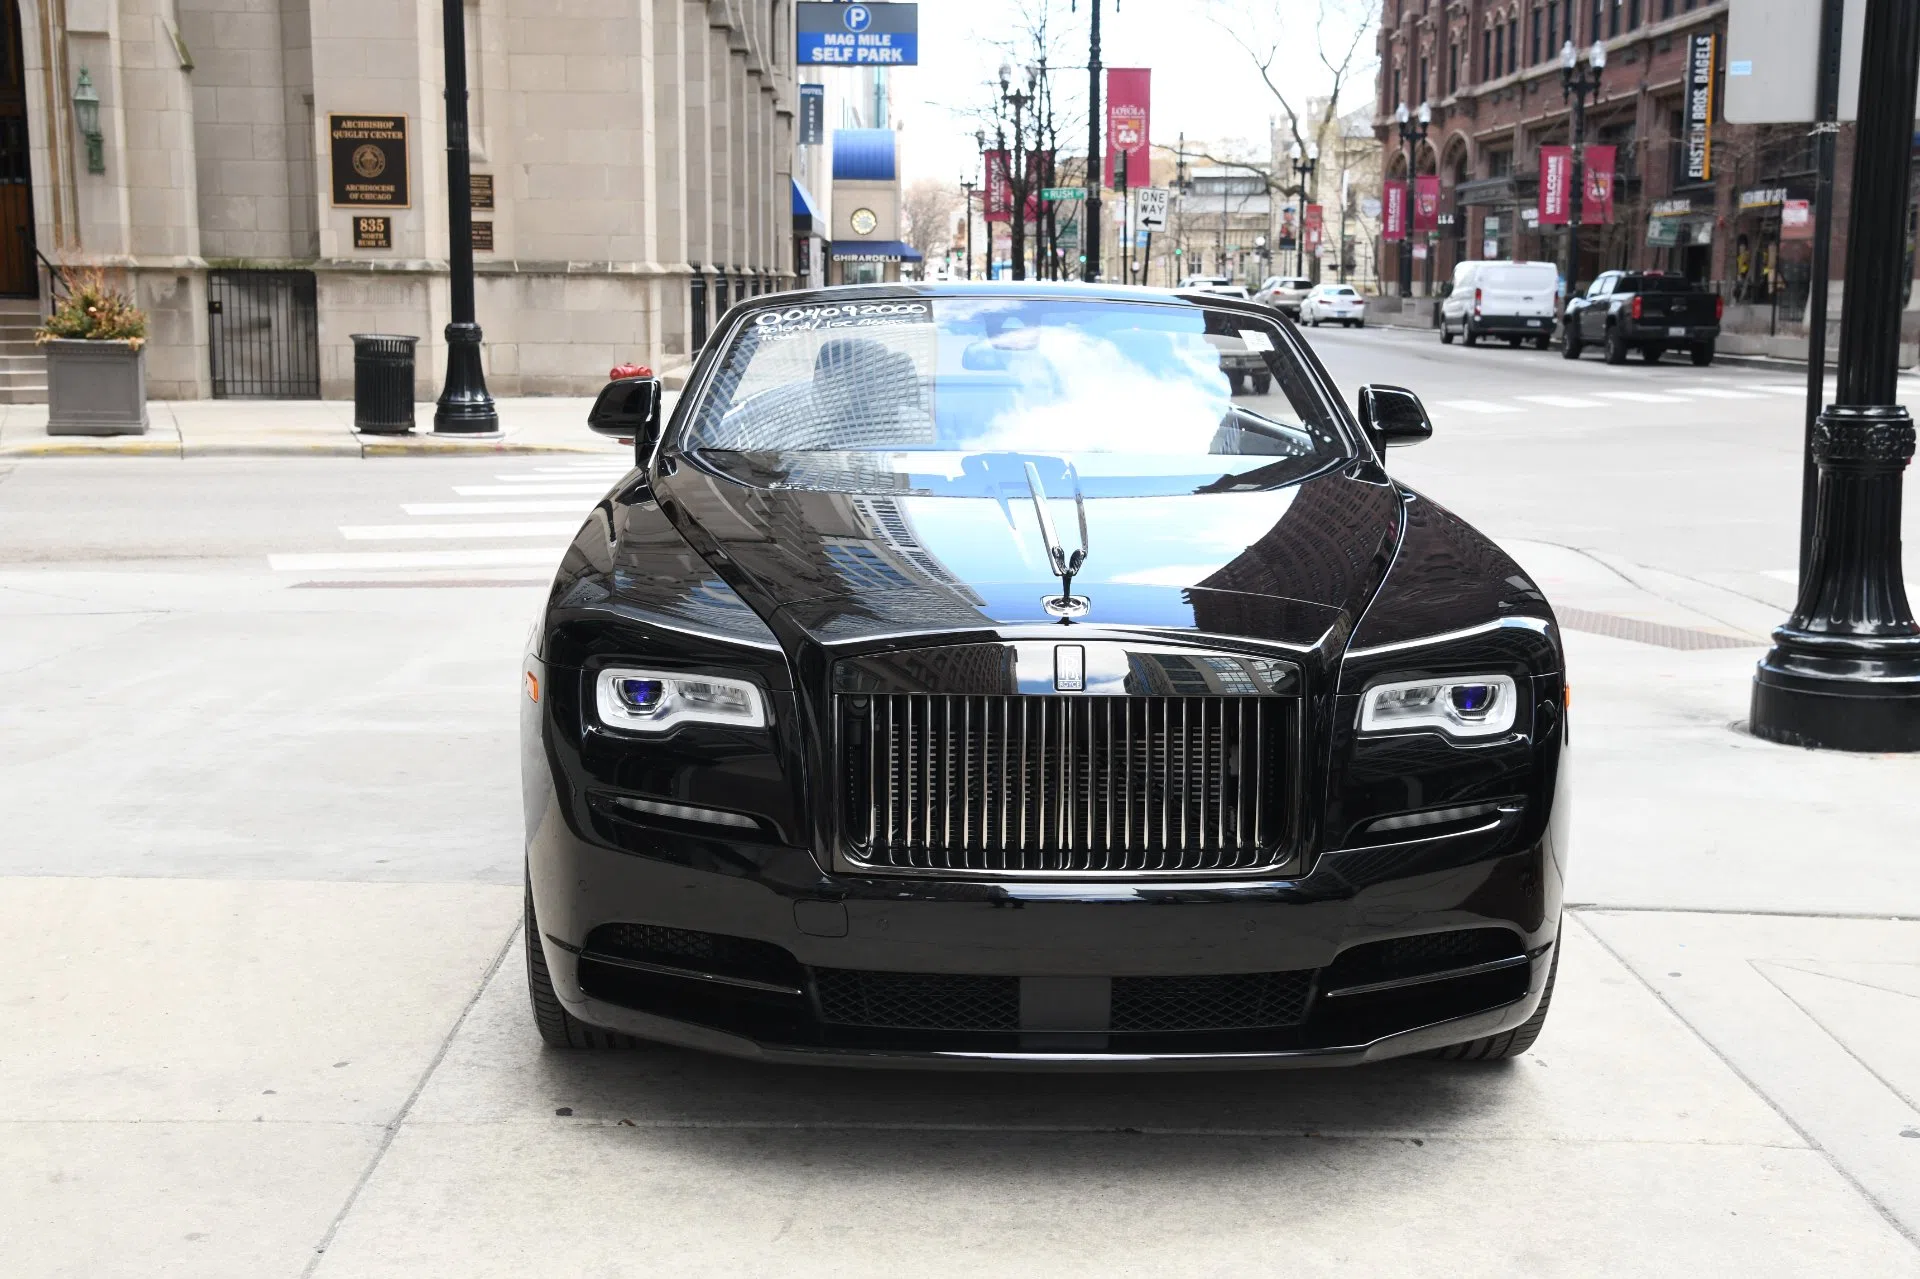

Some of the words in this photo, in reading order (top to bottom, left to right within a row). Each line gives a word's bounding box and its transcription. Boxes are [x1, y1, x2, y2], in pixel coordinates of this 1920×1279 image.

[850, 8, 866, 28] P
[824, 34, 855, 46] MAG
[858, 34, 892, 46] MILE
[812, 47, 854, 62] SELF
[857, 47, 904, 62] PARK
[1694, 36, 1711, 84] BAGELS
[1111, 106, 1146, 116] LOYOLA
[341, 120, 394, 130] ARCHBISHOP
[332, 130, 370, 140] QUIGLEY
[370, 131, 403, 140] CENTER
[1688, 122, 1706, 177] EINSTEIN
[345, 184, 395, 193] ARCHDIOCESE
[1545, 156, 1558, 215] WELCOME
[349, 192, 359, 201] OF
[360, 192, 392, 201] CHICAGO
[1050, 190, 1074, 199] RUSH
[1142, 191, 1165, 202] ONE
[1141, 203, 1164, 213] WAY
[1388, 188, 1396, 233] WELCOME
[359, 218, 384, 232] 835
[832, 253, 901, 262] GHIRARDELLI
